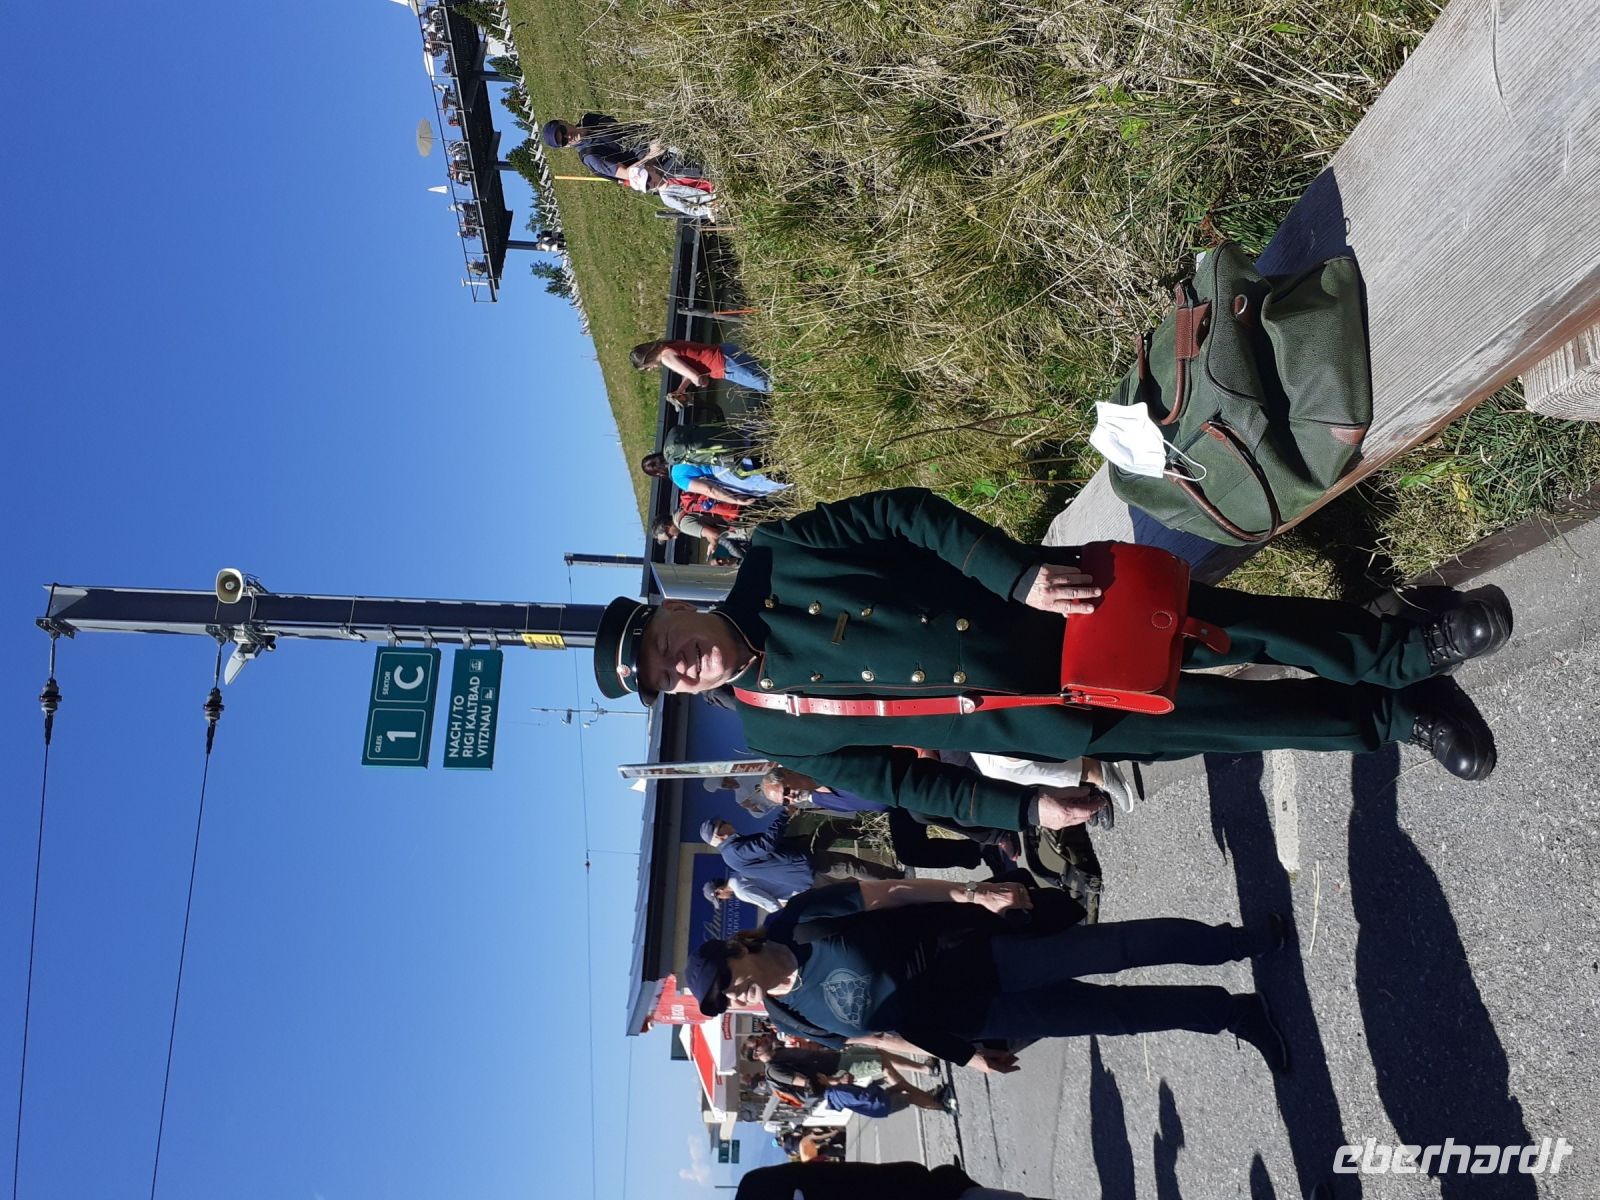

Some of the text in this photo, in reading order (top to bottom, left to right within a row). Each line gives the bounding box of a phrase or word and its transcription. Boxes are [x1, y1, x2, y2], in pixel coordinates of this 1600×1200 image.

[382, 672, 390, 695] SEKTOR
[393, 665, 425, 690] C
[453, 695, 464, 711] TO
[462, 676, 480, 757] RIGI KALTBAD
[386, 731, 416, 742] 1
[448, 722, 462, 758] NACH
[477, 705, 492, 757] VITZNAU
